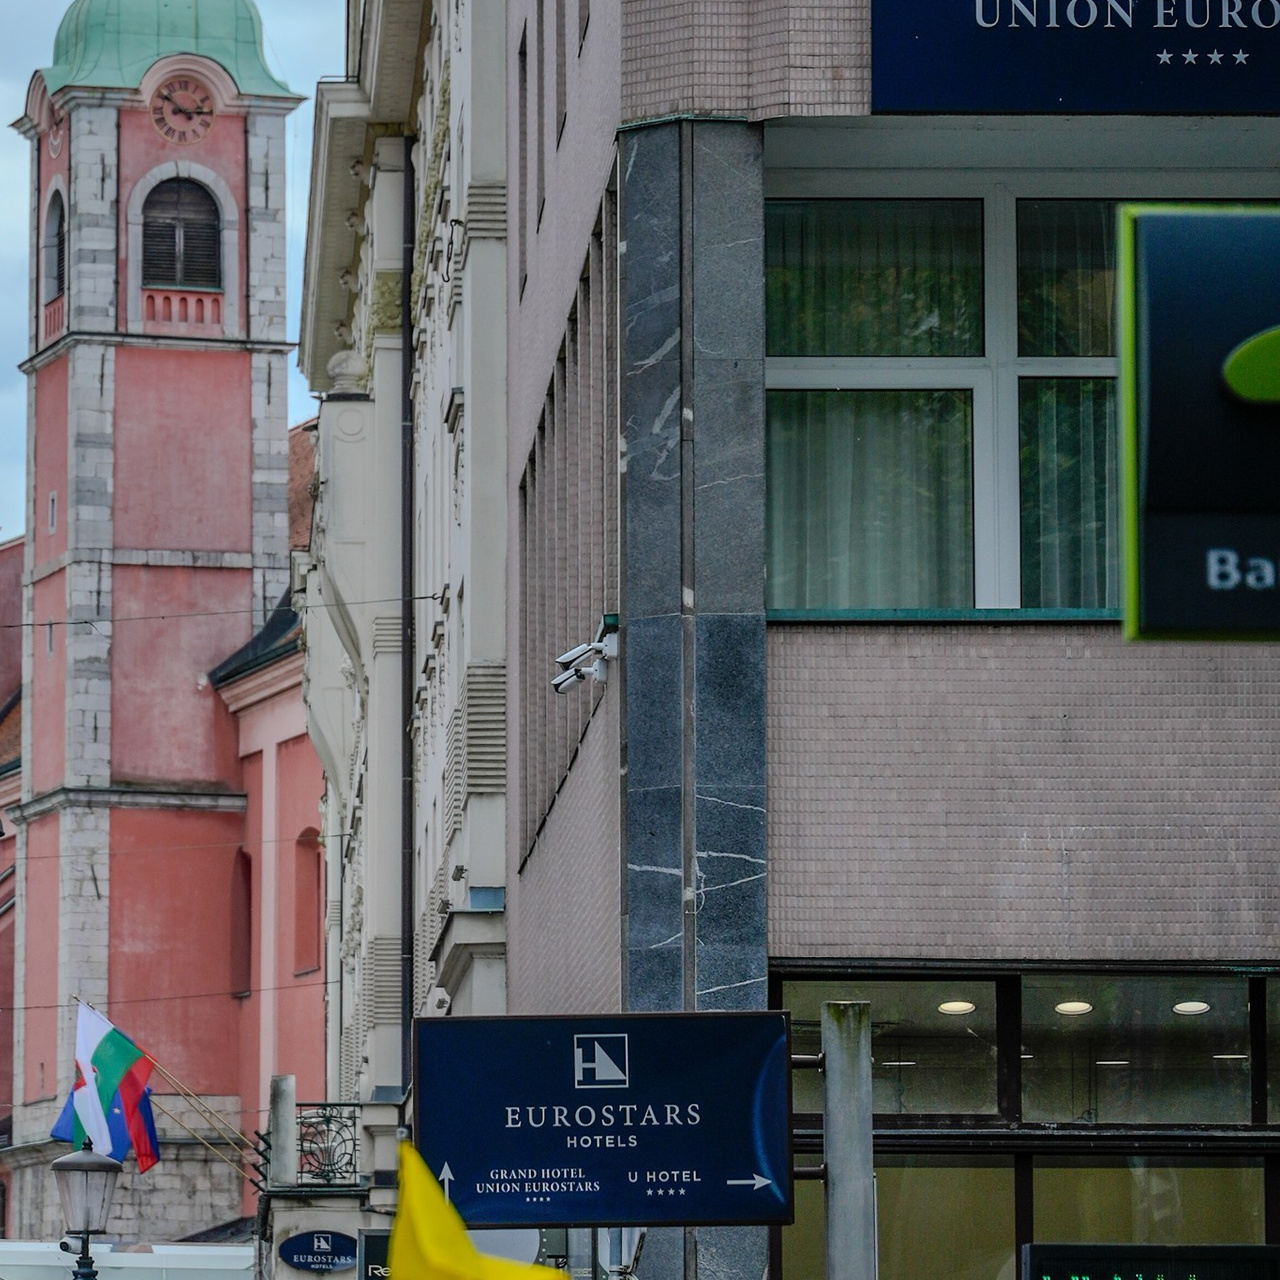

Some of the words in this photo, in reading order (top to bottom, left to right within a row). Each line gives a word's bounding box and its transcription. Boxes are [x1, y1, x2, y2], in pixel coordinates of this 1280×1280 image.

[1206, 547, 1280, 591] Ba
[505, 1103, 701, 1128] EUROSTARS
[567, 1134, 638, 1148] HOTELS
[490, 1168, 537, 1180] GRAND
[541, 1168, 586, 1179] HOTEL
[628, 1171, 638, 1183] U
[647, 1170, 702, 1183] HOTEL
[476, 1182, 520, 1194] UNION
[525, 1181, 600, 1193] EUROSTARS
[293, 1254, 352, 1264] EUROSTARS
